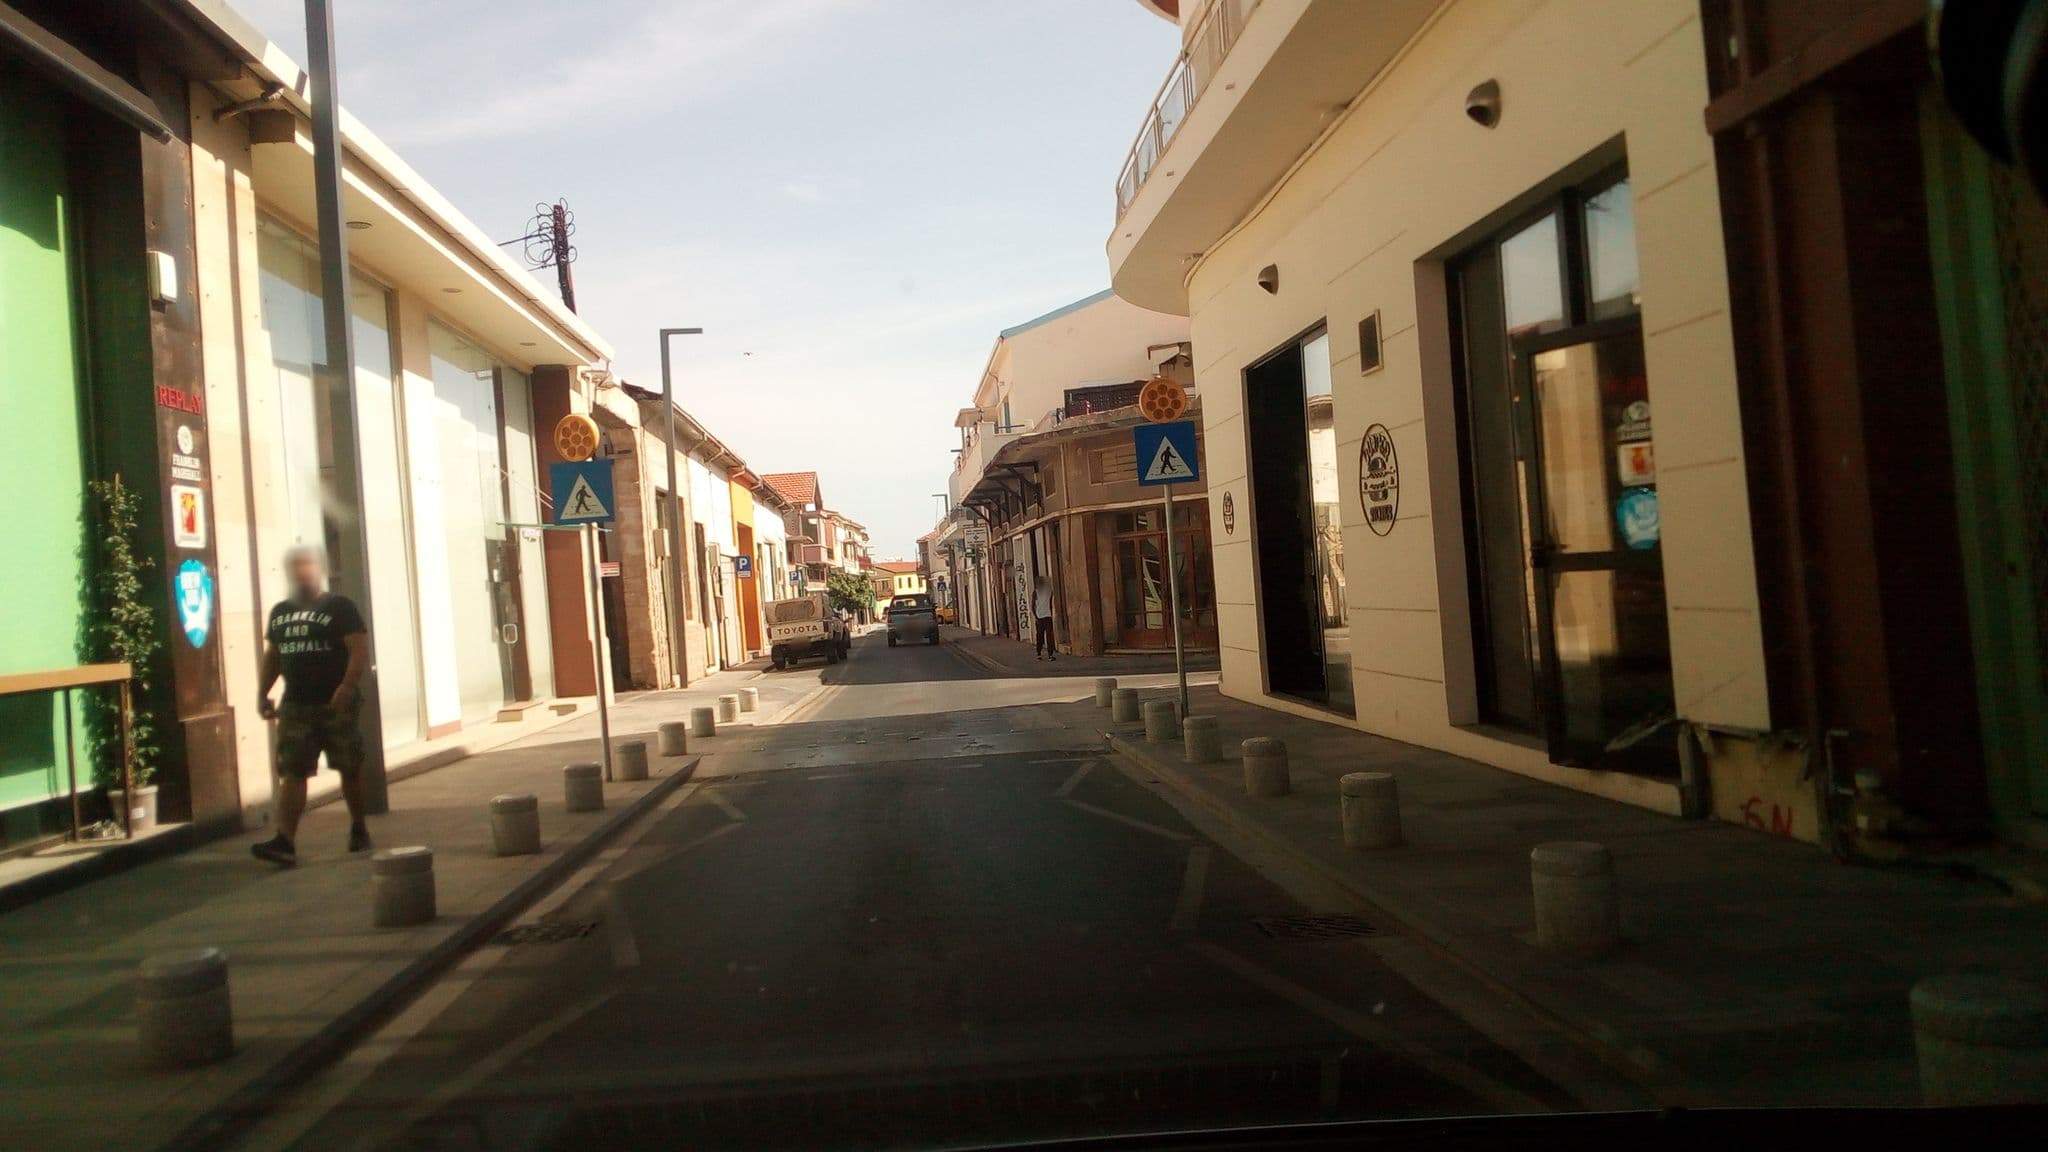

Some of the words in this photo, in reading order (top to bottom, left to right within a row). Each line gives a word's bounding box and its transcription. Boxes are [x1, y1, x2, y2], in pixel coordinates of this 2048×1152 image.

[157, 385, 202, 415] REPLAY
[739, 558, 748, 570] P
[272, 610, 333, 632] FRANKLIN
[284, 624, 310, 638] AND
[777, 625, 819, 636] TOYOTA
